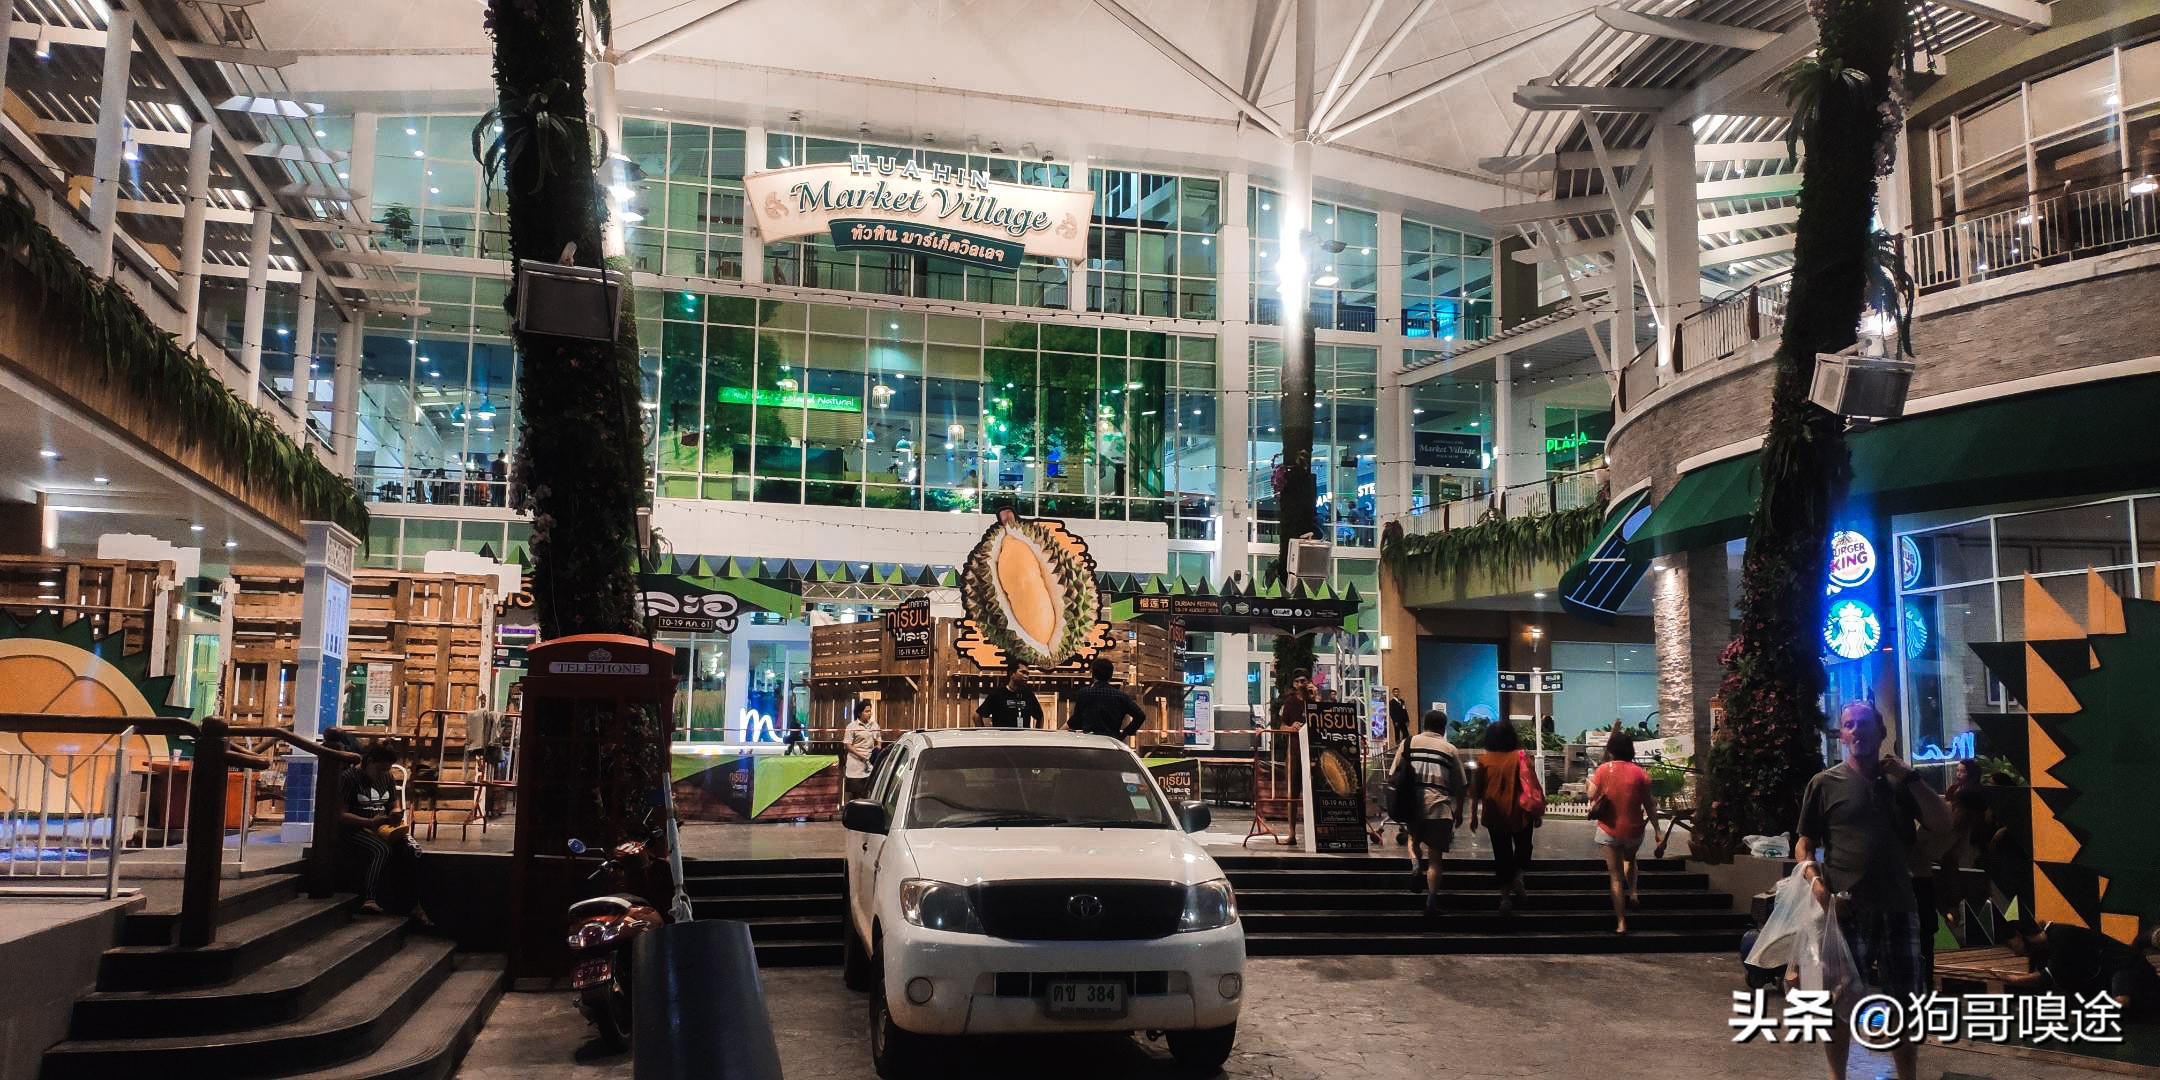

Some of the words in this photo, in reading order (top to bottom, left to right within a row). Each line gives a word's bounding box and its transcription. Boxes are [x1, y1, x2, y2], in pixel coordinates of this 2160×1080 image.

[850, 153, 922, 180] HUA
[932, 162, 991, 192] HIN
[790, 180, 927, 214] Market
[931, 187, 1052, 237] Village
[1546, 431, 1589, 453] PLAZA
[1830, 551, 1868, 573] KING
[560, 663, 641, 674] TELEPHONE
[1087, 985, 1115, 1002] 384
